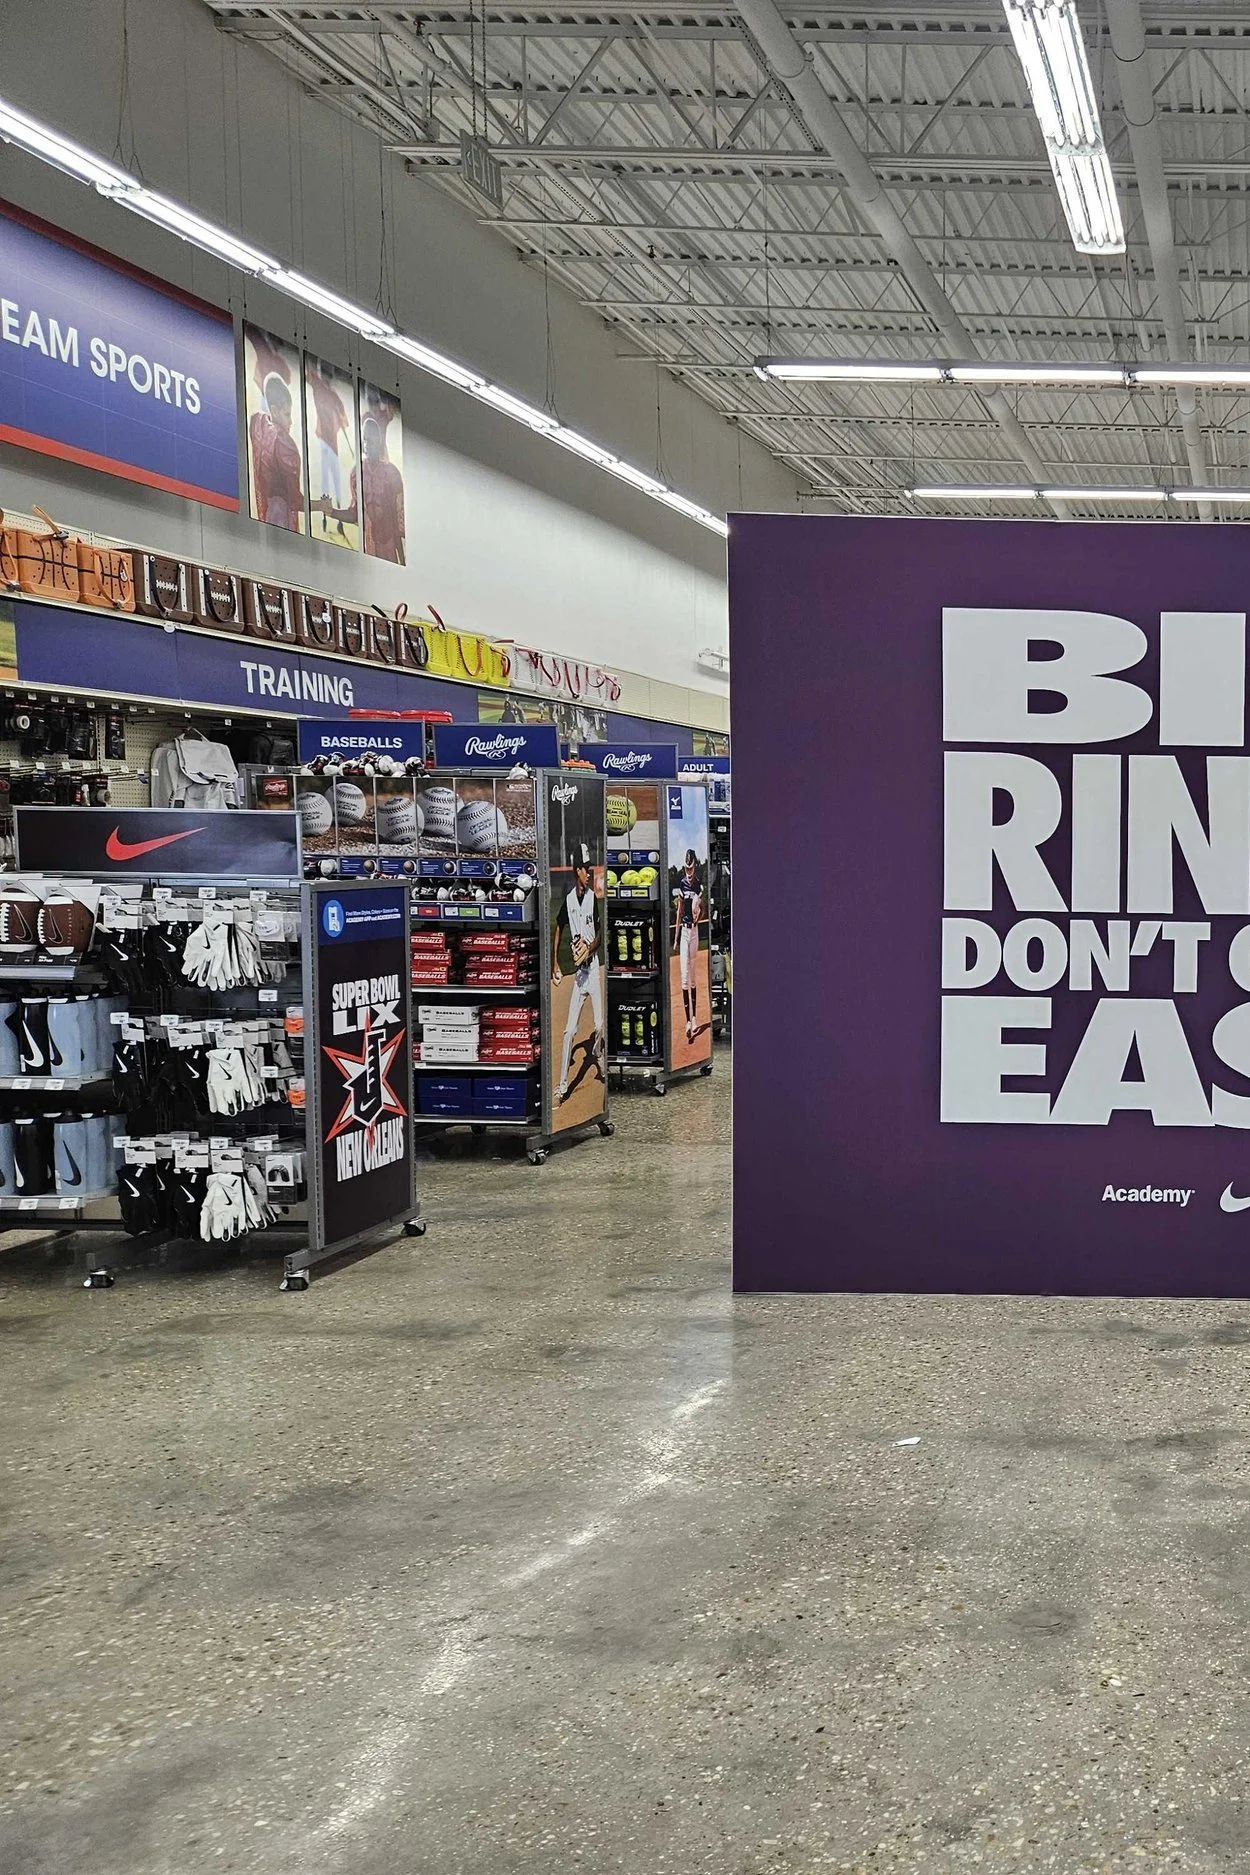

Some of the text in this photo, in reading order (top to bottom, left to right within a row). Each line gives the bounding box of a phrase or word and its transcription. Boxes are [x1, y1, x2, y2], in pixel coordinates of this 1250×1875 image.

[1, 298, 201, 415] EAM SPORTS
[240, 661, 354, 707] TRAINING
[321, 736, 402, 748] BASEBALLS
[465, 734, 527, 755] Rawlings
[602, 751, 652, 768] Rawlings
[683, 763, 714, 772] ADULT
[552, 783, 578, 802] Rawlings
[941, 917, 1211, 993] DON'T
[332, 974, 401, 1011] SUPER BOWL
[333, 1000, 401, 1036] LIX
[336, 1116, 404, 1182] NEW ORLEANS
[1102, 1184, 1194, 1207] Academy
